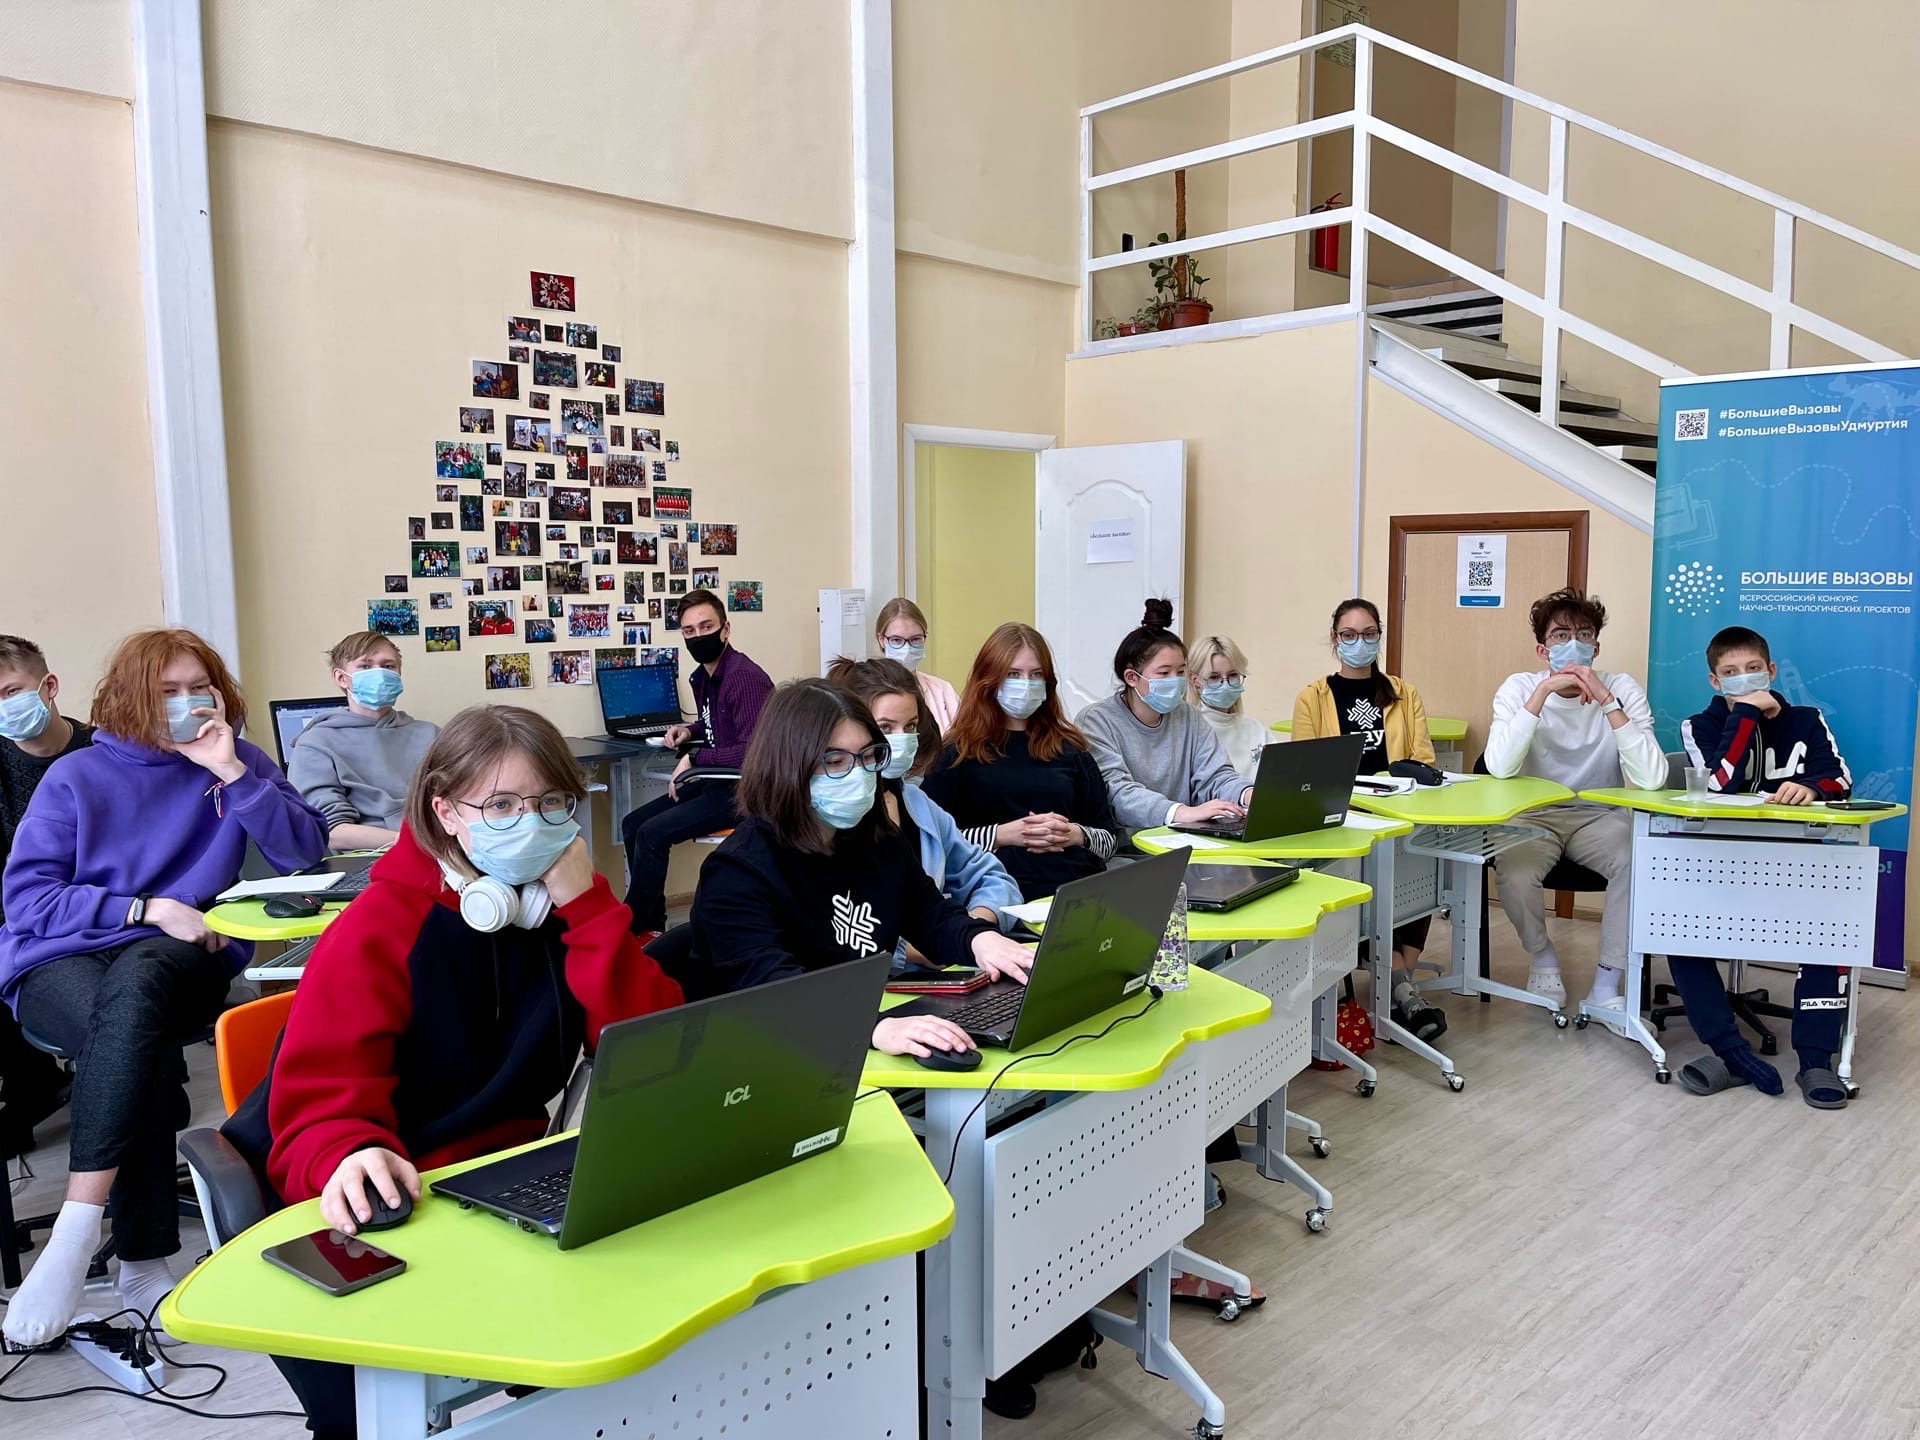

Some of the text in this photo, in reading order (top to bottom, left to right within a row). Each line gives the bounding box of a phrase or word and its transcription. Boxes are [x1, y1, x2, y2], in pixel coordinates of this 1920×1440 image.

[1719, 404, 1841, 420] #БольшиеВызовы
[1718, 419, 1908, 438] #БольшиеВызовыУдмуртия
[1741, 572, 1913, 585] БОЛЬШИЕ ВЫЗОВЫ
[1740, 593, 1815, 602] ВСЕРОССИЙСКИЙ
[1739, 604, 1911, 615] НАУЧНО-ТЕХНОЛОГИЧЕСКИХ ПРОЕКТОВ
[1099, 937, 1114, 952] ICL
[723, 1085, 752, 1107] ICL
